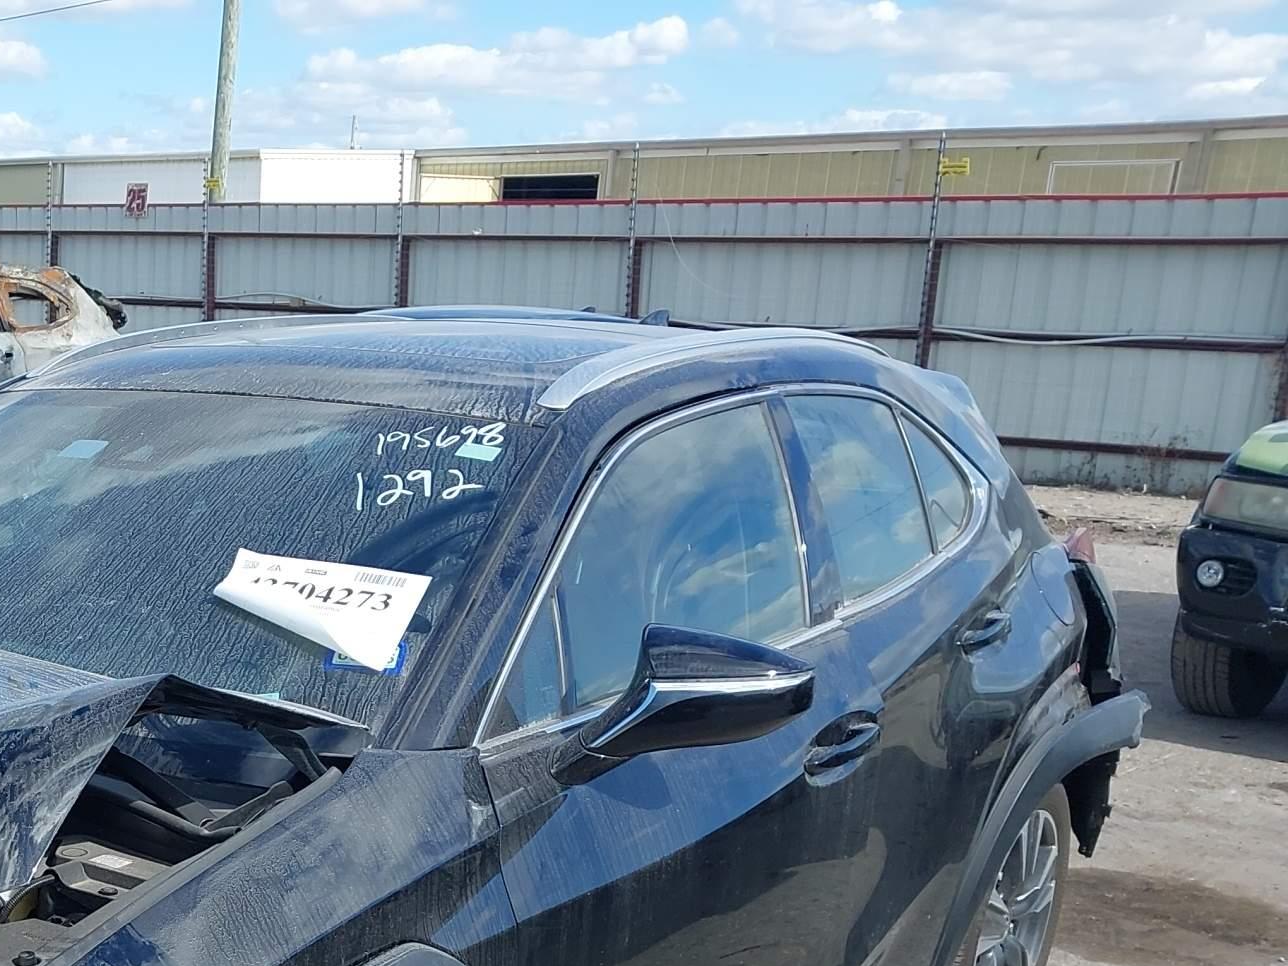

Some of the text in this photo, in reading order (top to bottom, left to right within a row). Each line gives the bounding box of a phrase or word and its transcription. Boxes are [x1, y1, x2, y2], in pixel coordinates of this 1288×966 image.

[126, 187, 147, 213] 25
[376, 421, 507, 455] 195698
[356, 469, 485, 511] 1292
[250, 576, 394, 612] 04273
